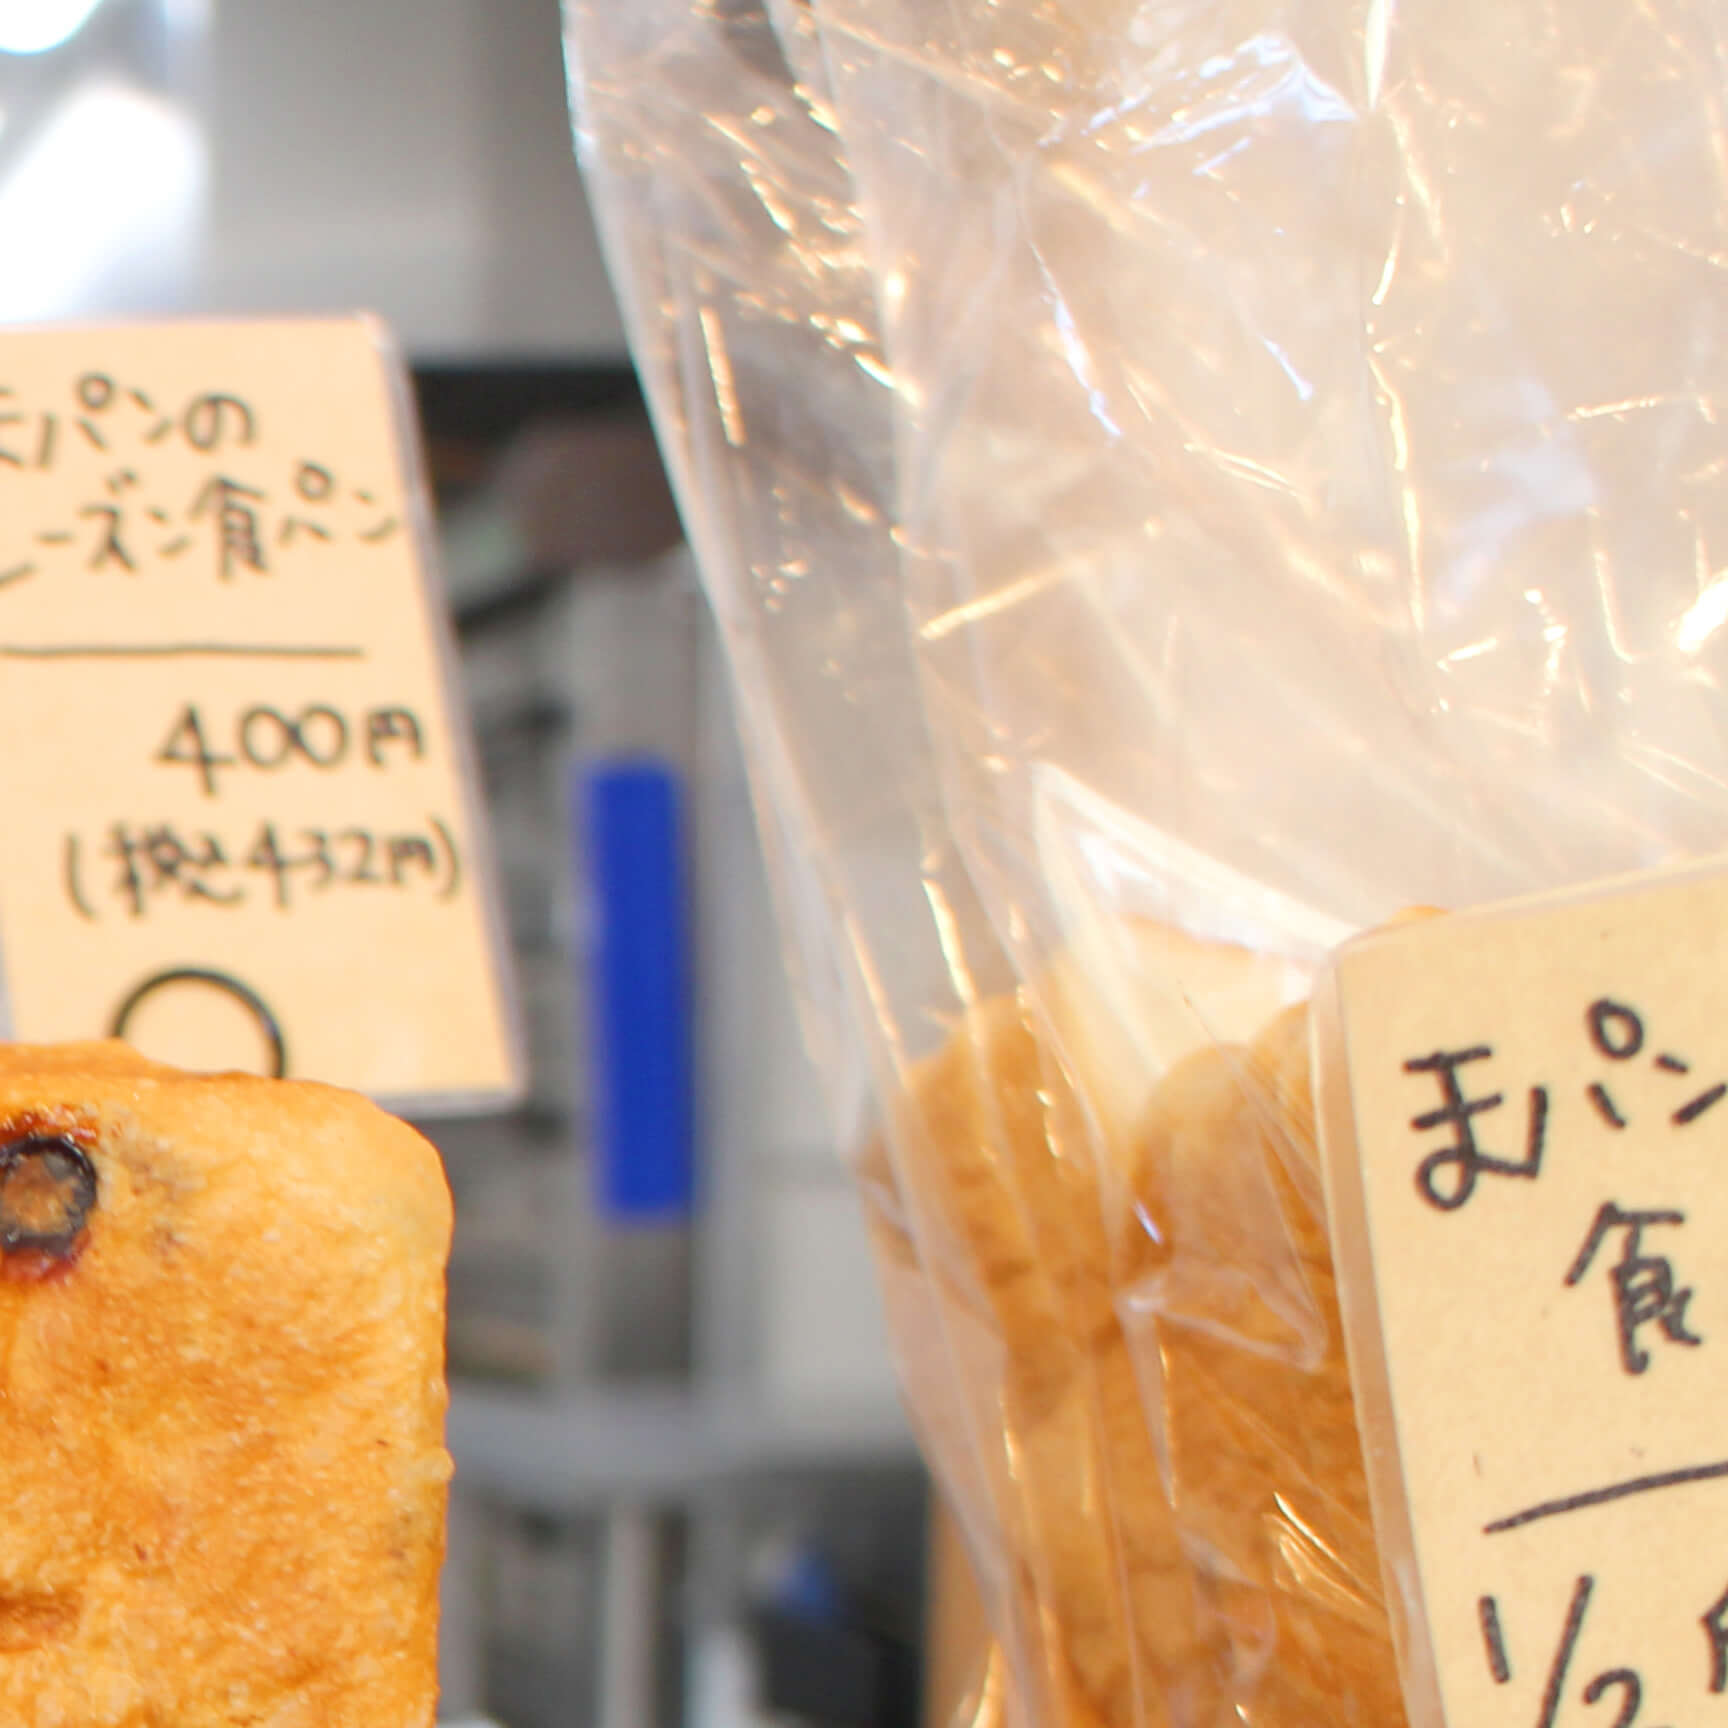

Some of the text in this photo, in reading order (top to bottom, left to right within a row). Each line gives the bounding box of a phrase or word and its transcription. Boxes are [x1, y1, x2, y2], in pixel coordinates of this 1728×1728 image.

[153, 702, 426, 799] 400円
[1401, 997, 1728, 1213] まパン
[1562, 1200, 1704, 1376] 食
